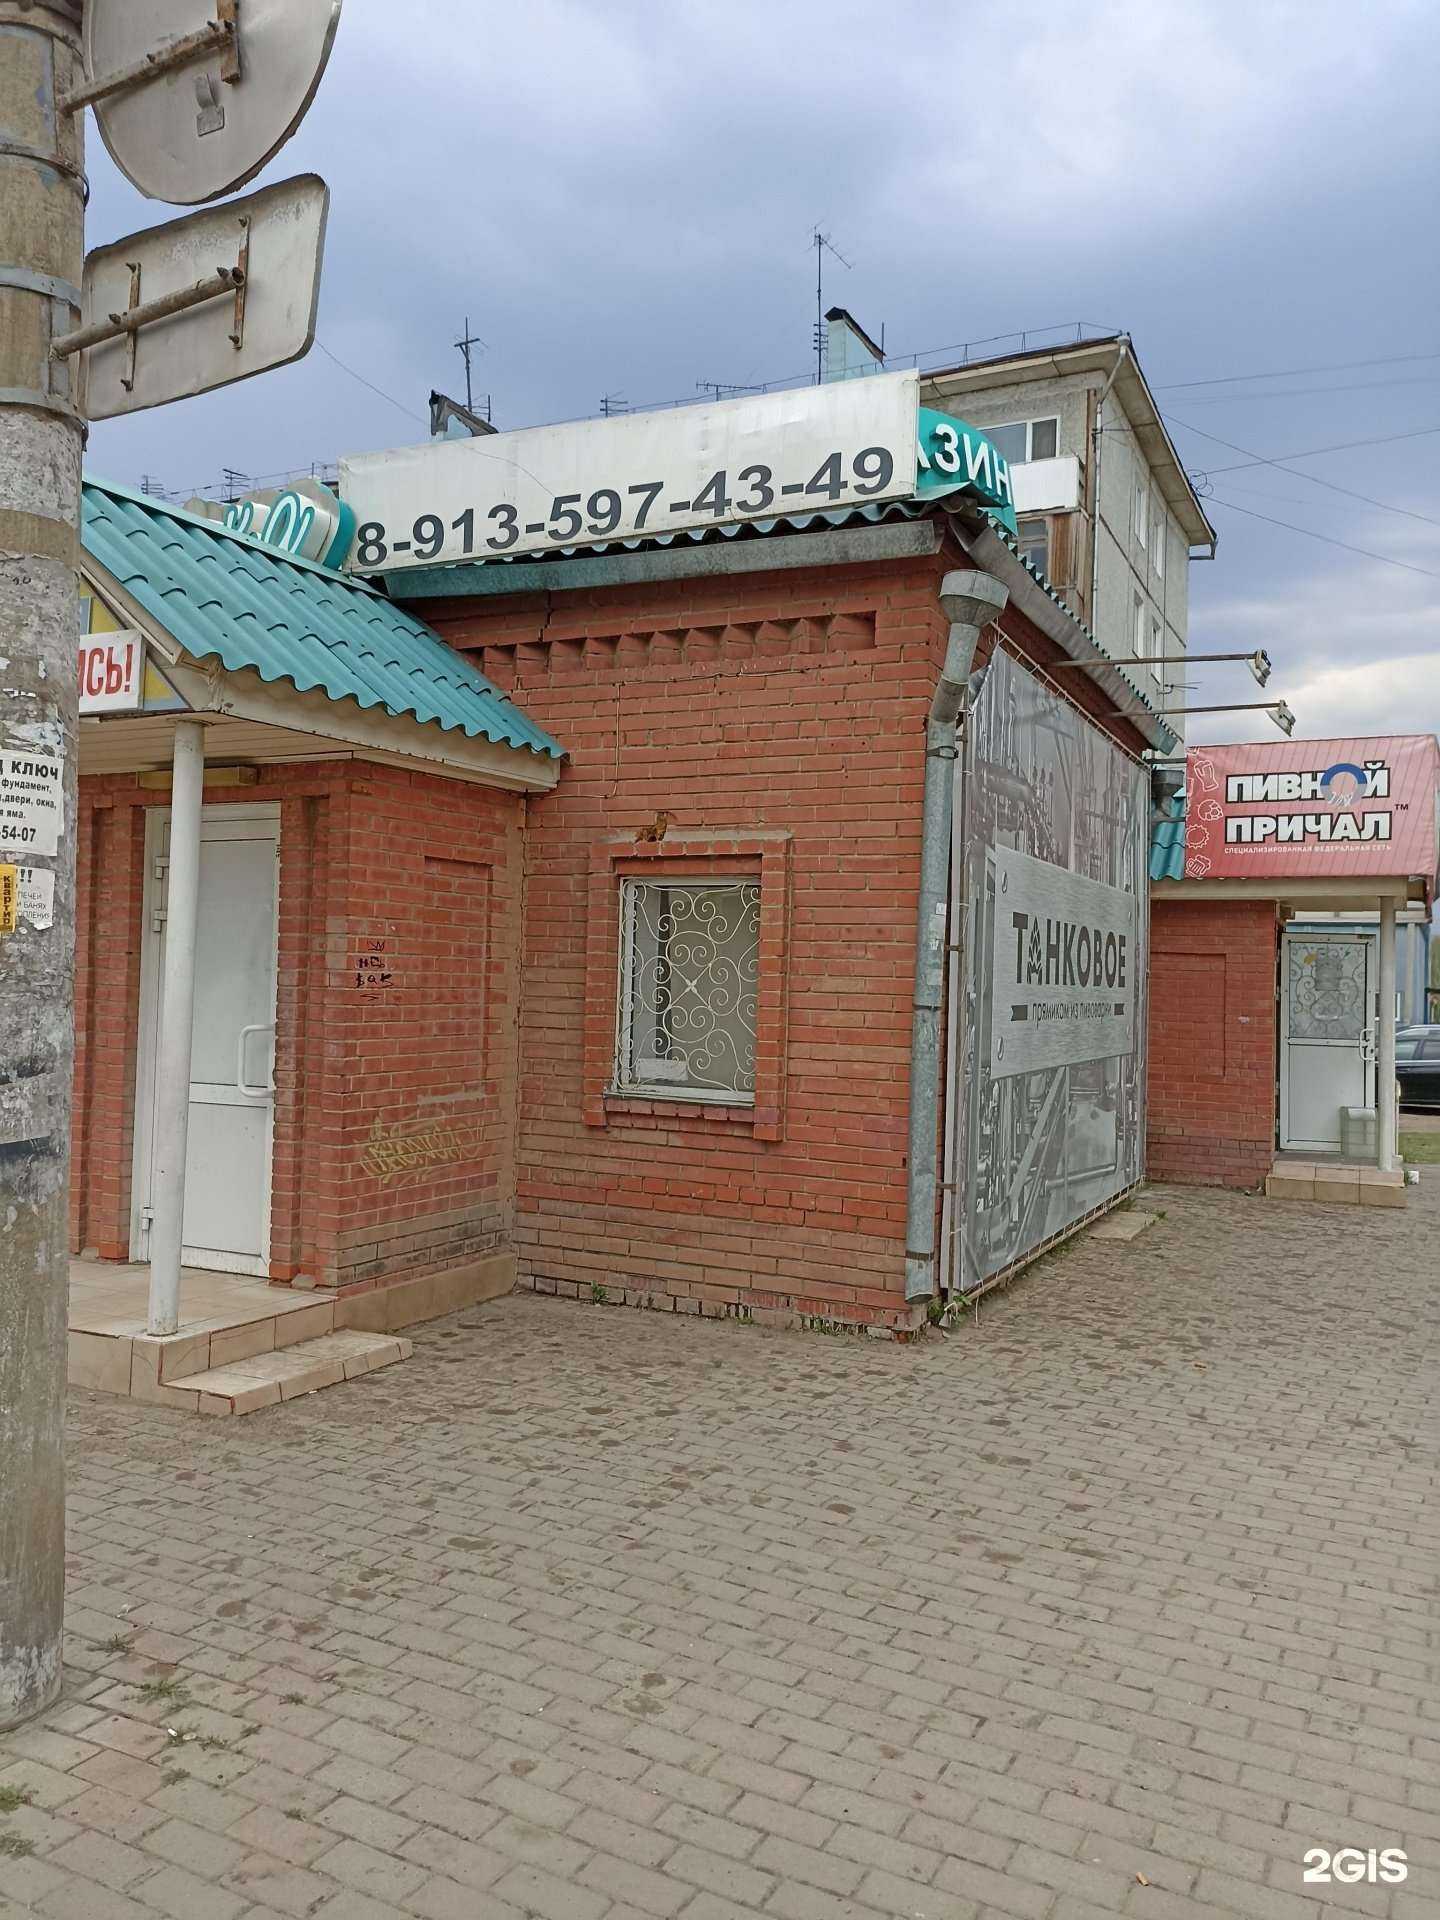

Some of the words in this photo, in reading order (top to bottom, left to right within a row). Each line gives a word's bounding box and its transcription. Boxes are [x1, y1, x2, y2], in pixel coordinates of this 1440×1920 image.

[356, 446, 895, 567] 8-913-597-43-49
[1226, 760, 1392, 806] ПИВНОЙ
[1224, 845, 1312, 855] СПЕЦИАЛИЗИРОВАННАЯ
[1225, 811, 1393, 845] ПРИЧАЛ
[1012, 911, 1126, 988] ТАНКОВОЕ
